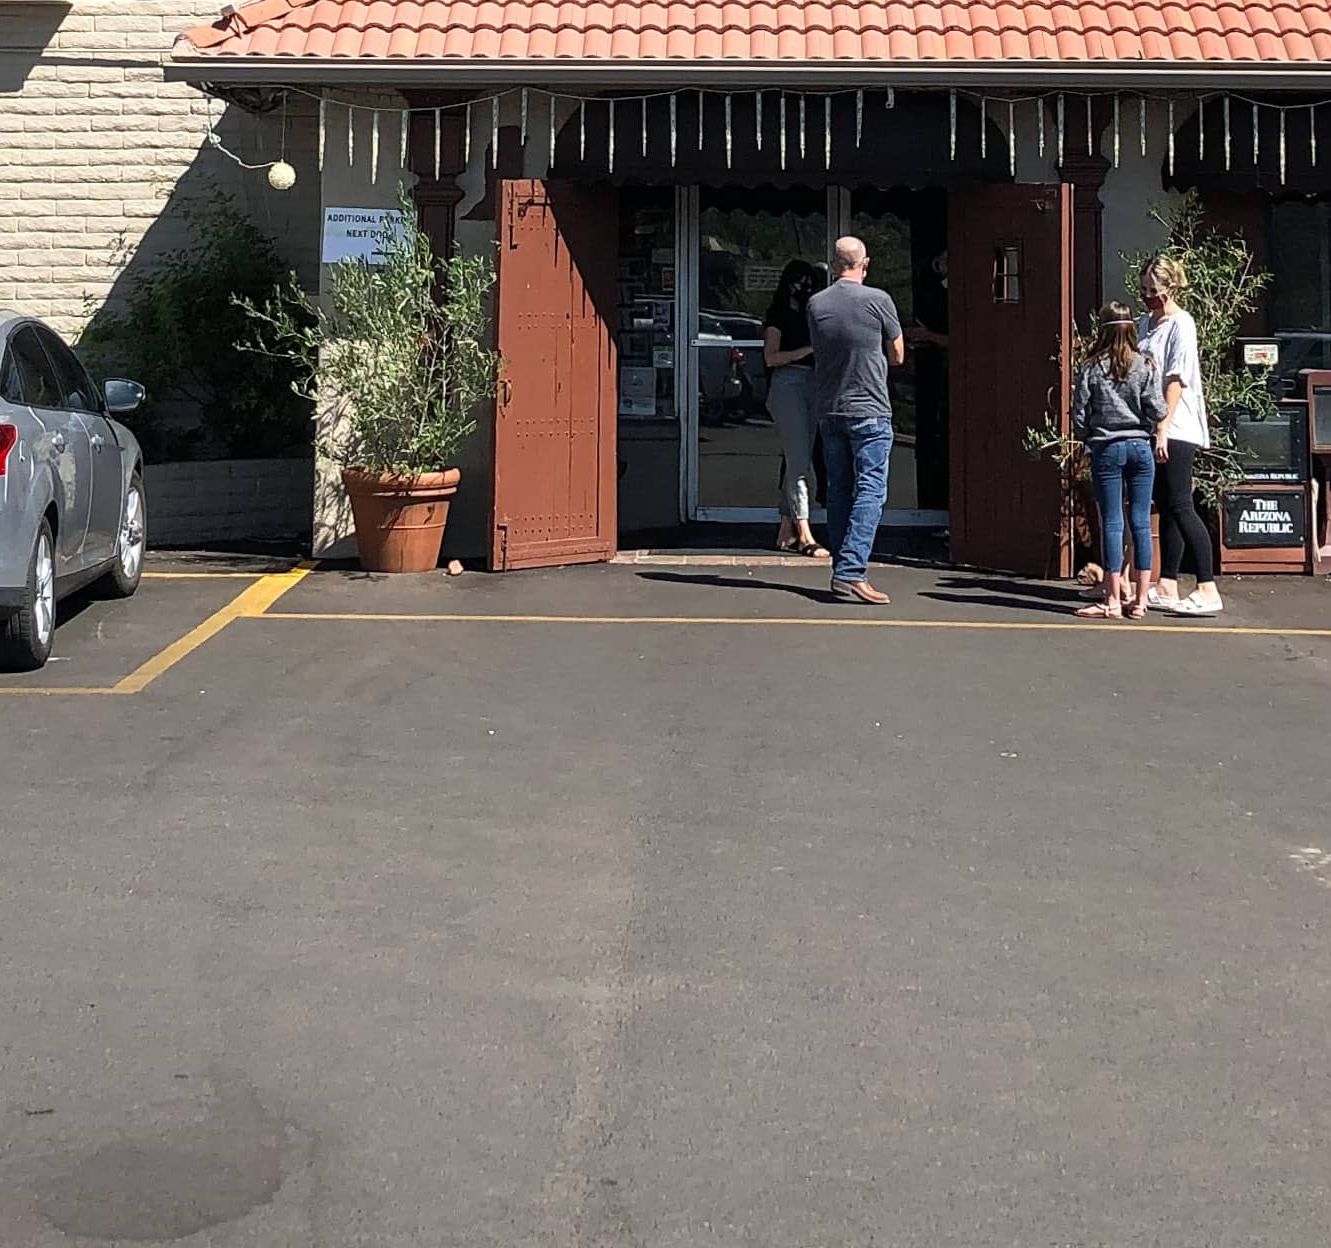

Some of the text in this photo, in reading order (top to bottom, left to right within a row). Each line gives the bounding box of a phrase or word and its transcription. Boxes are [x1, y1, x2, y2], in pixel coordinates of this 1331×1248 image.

[327, 214, 376, 223] ADDITIONAL
[346, 229, 367, 238] NEXT
[1252, 498, 1278, 510] THE
[1240, 509, 1291, 522] ARIZONA
[1238, 521, 1294, 533] REPUBLIC
